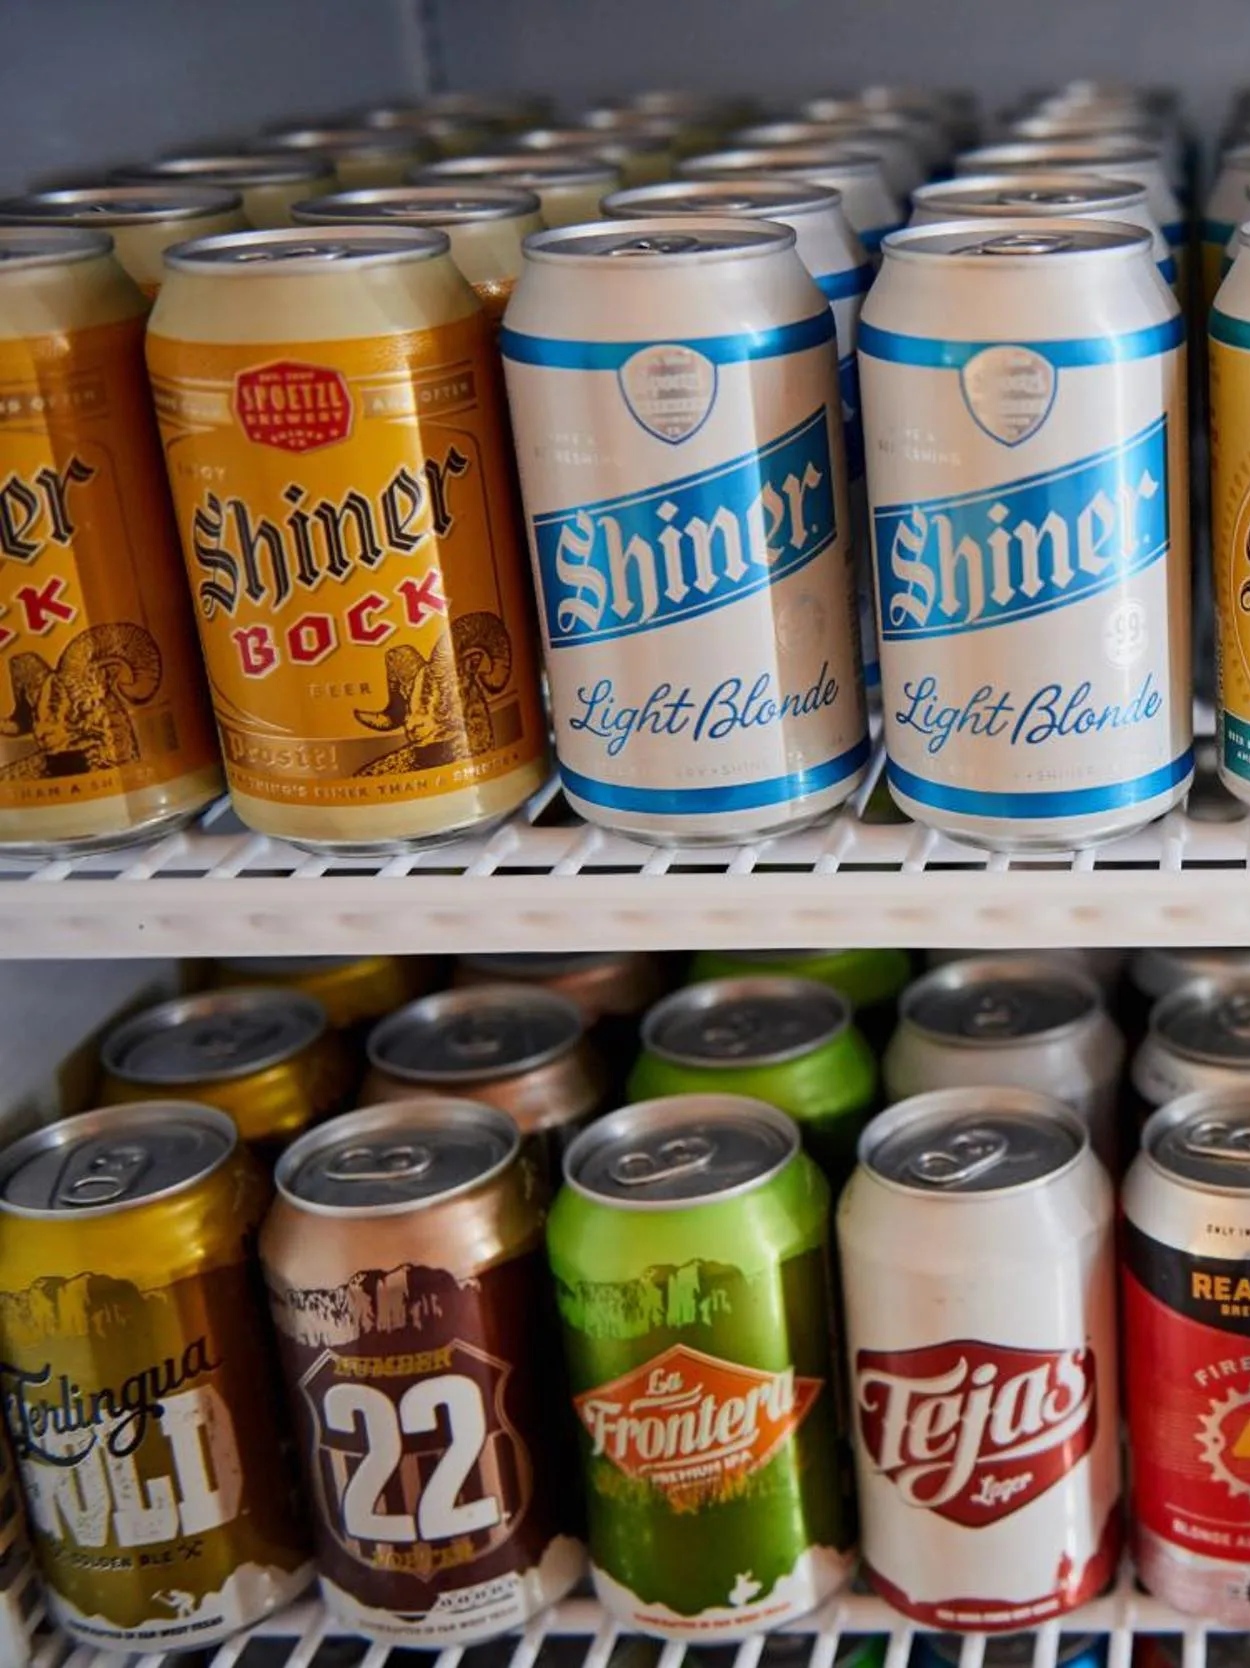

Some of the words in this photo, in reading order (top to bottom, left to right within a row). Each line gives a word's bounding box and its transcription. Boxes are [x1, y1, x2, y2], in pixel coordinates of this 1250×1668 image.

[192, 446, 470, 618] Shiner
[231, 569, 450, 679] BOCK
[569, 679, 695, 757] Light
[692, 660, 840, 742] Blonde
[895, 676, 1015, 754] Light
[1010, 671, 1163, 746] Blonde
[376, 779, 428, 796] THAN
[1206, 1223, 1235, 1236] ONLY
[582, 1364, 795, 1459] Frontera
[645, 1368, 684, 1396] La
[857, 1347, 1088, 1509] Tejas
[324, 1373, 501, 1542] 22
[970, 1471, 1034, 1506] Lager
